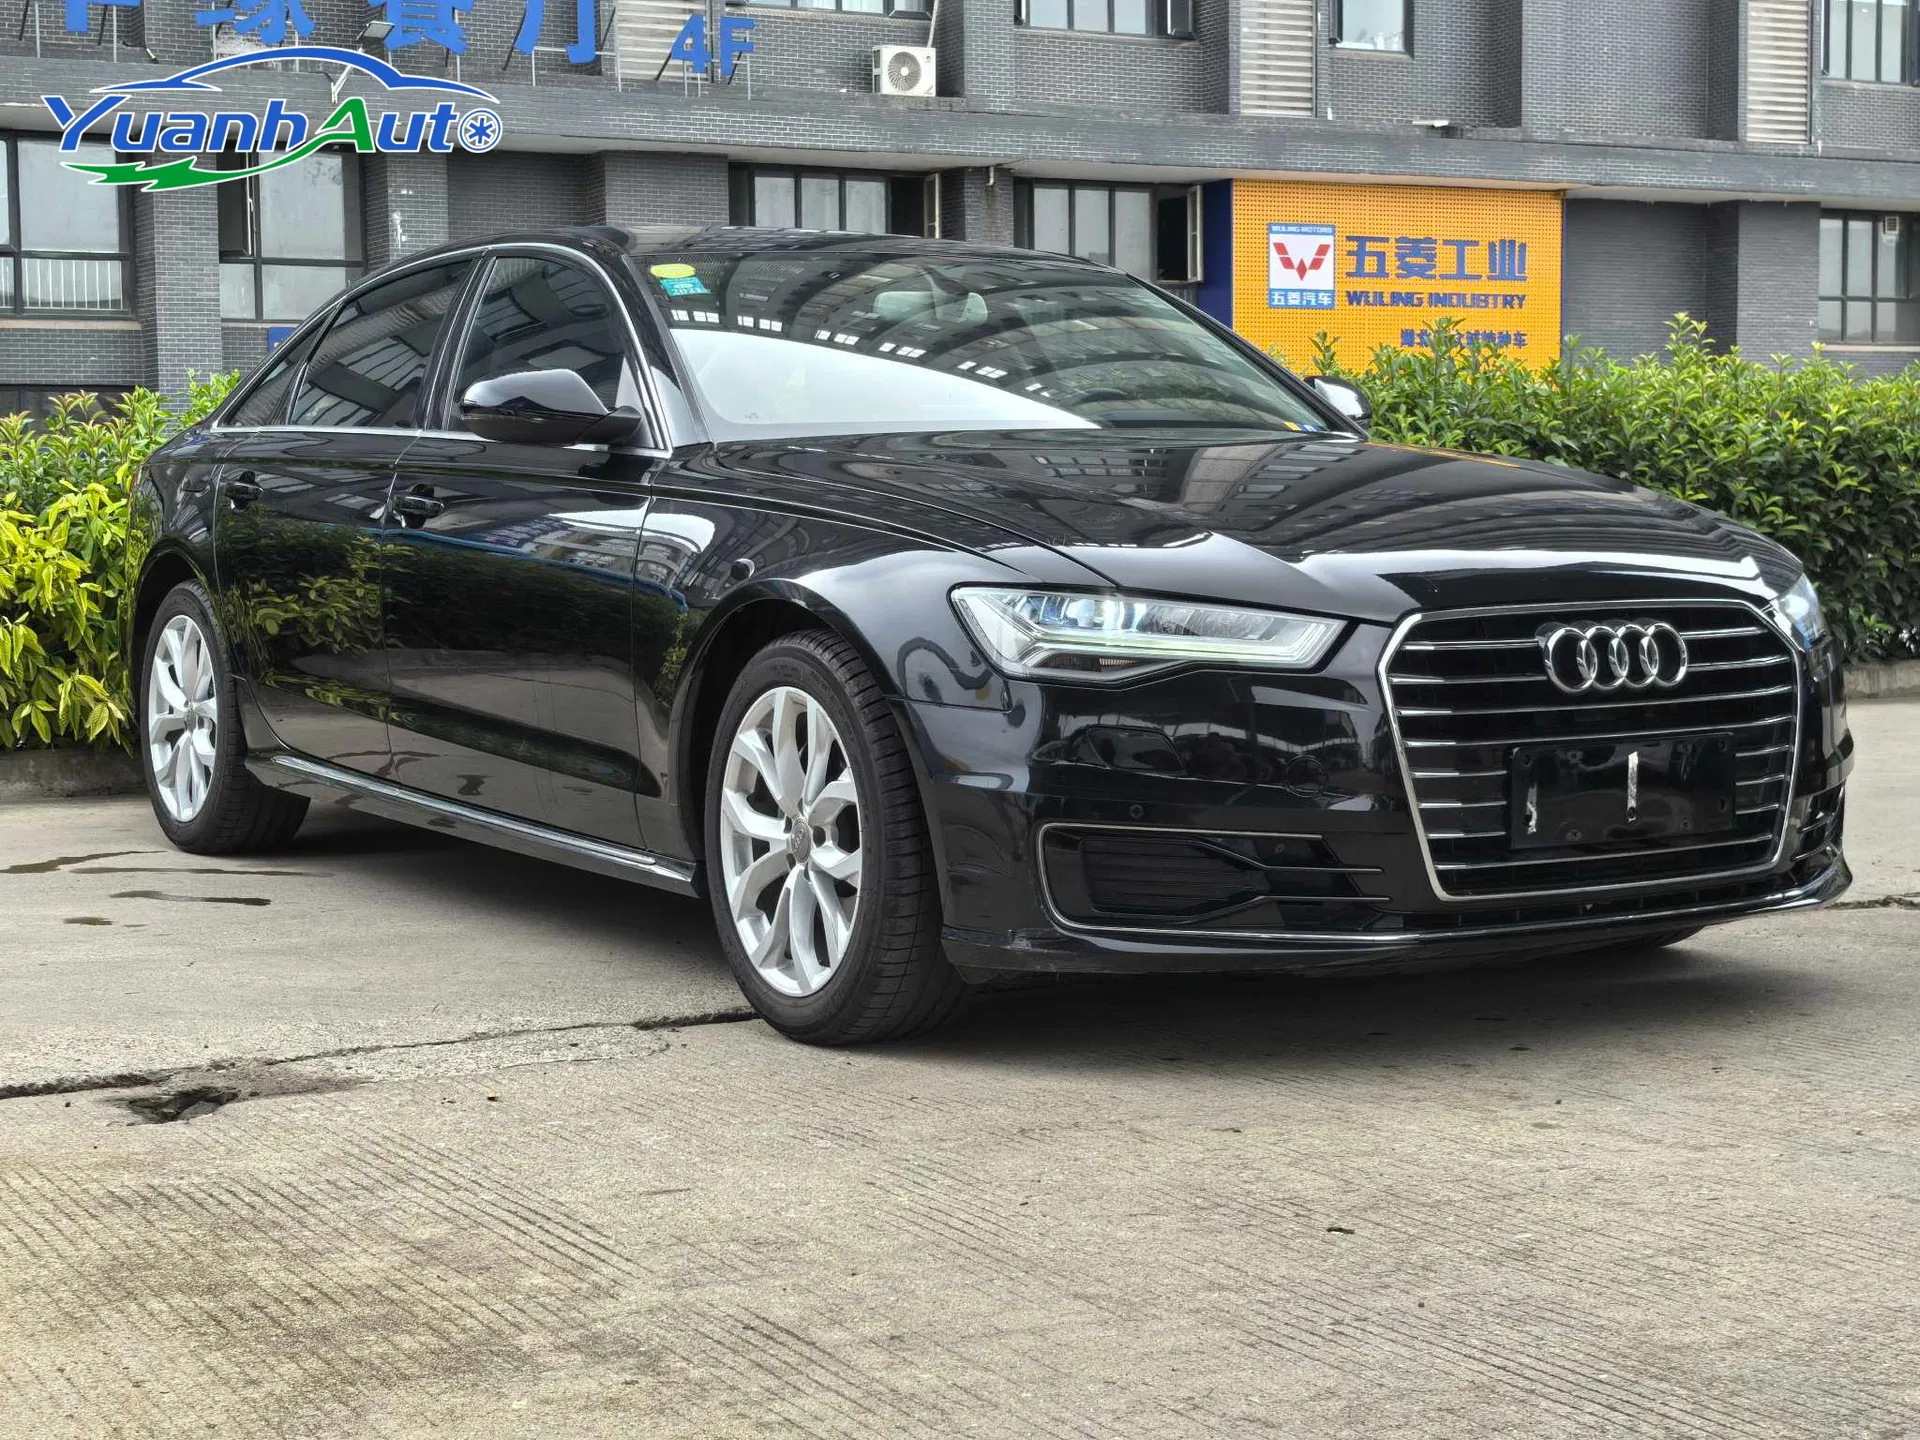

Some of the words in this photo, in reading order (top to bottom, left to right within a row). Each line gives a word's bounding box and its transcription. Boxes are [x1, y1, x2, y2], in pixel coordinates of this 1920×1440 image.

[671, 14, 756, 75] 4F
[1345, 235, 1527, 282] 五菱工业
[1271, 291, 1332, 306] 五菱汽车
[1345, 291, 1424, 307] WULING
[1428, 292, 1526, 309] INDUSTRY
